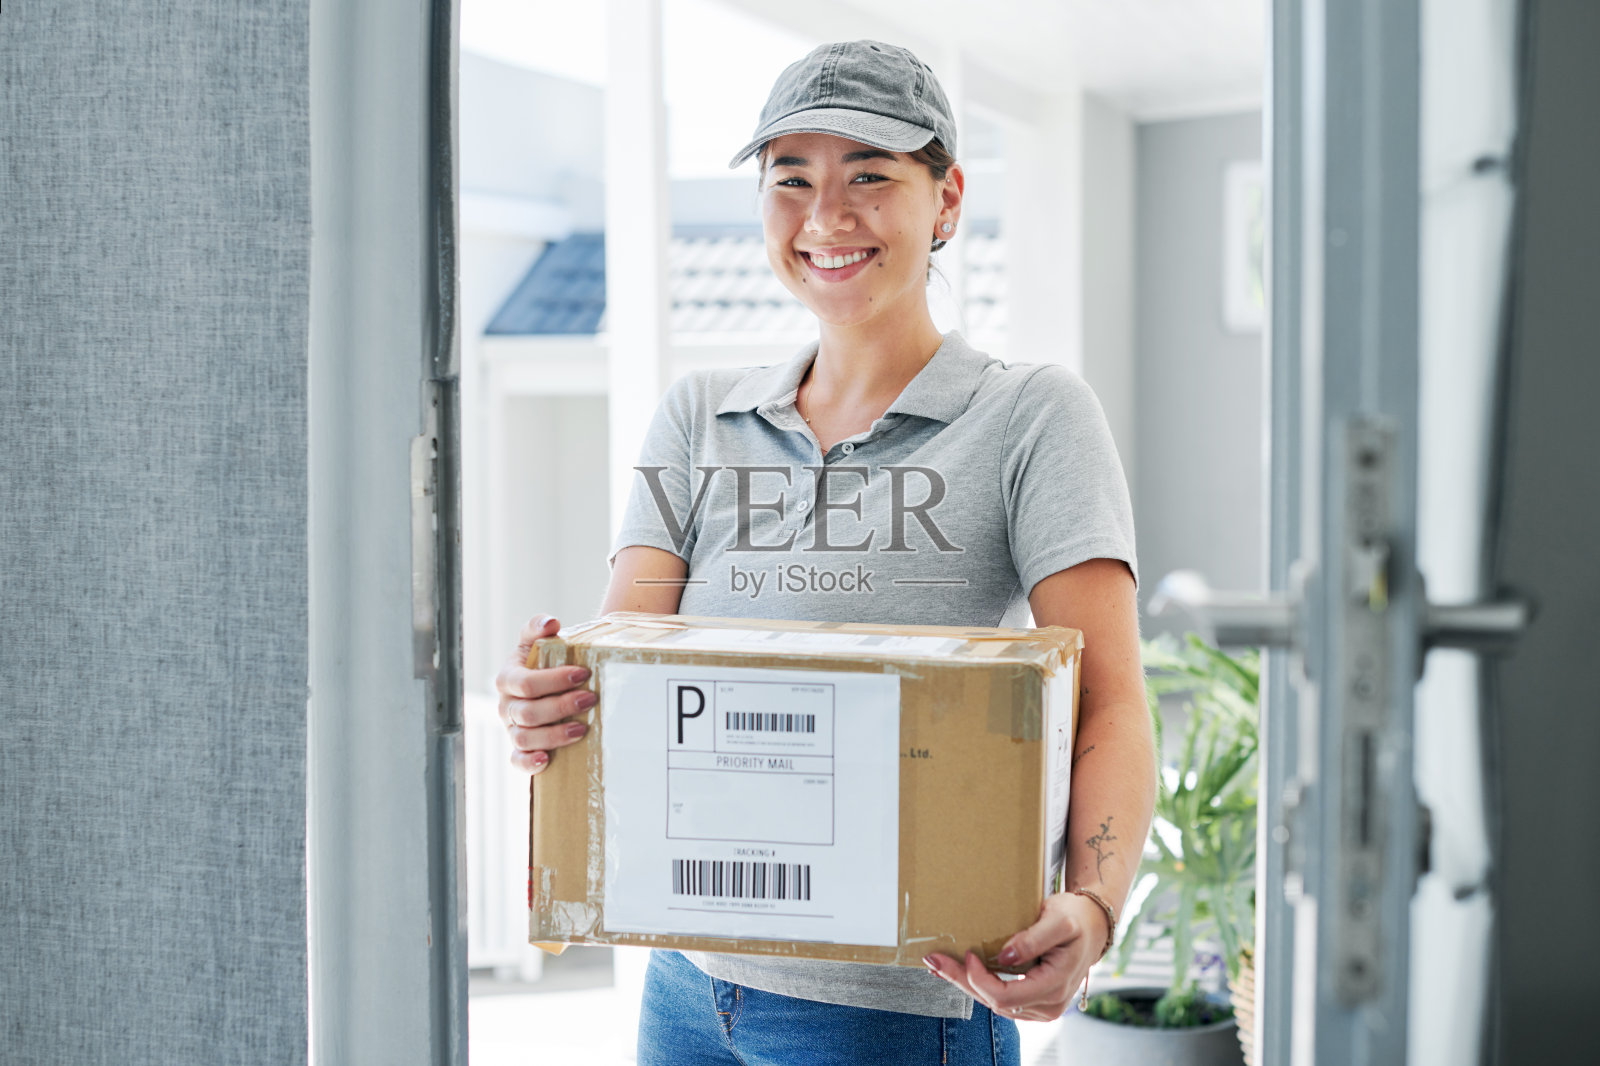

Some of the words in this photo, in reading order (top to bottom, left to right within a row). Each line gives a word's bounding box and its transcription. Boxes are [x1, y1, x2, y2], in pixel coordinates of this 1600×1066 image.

[677, 685, 706, 744] P
[716, 755, 765, 769] PRIORITY
[767, 758, 795, 771] MAIL
